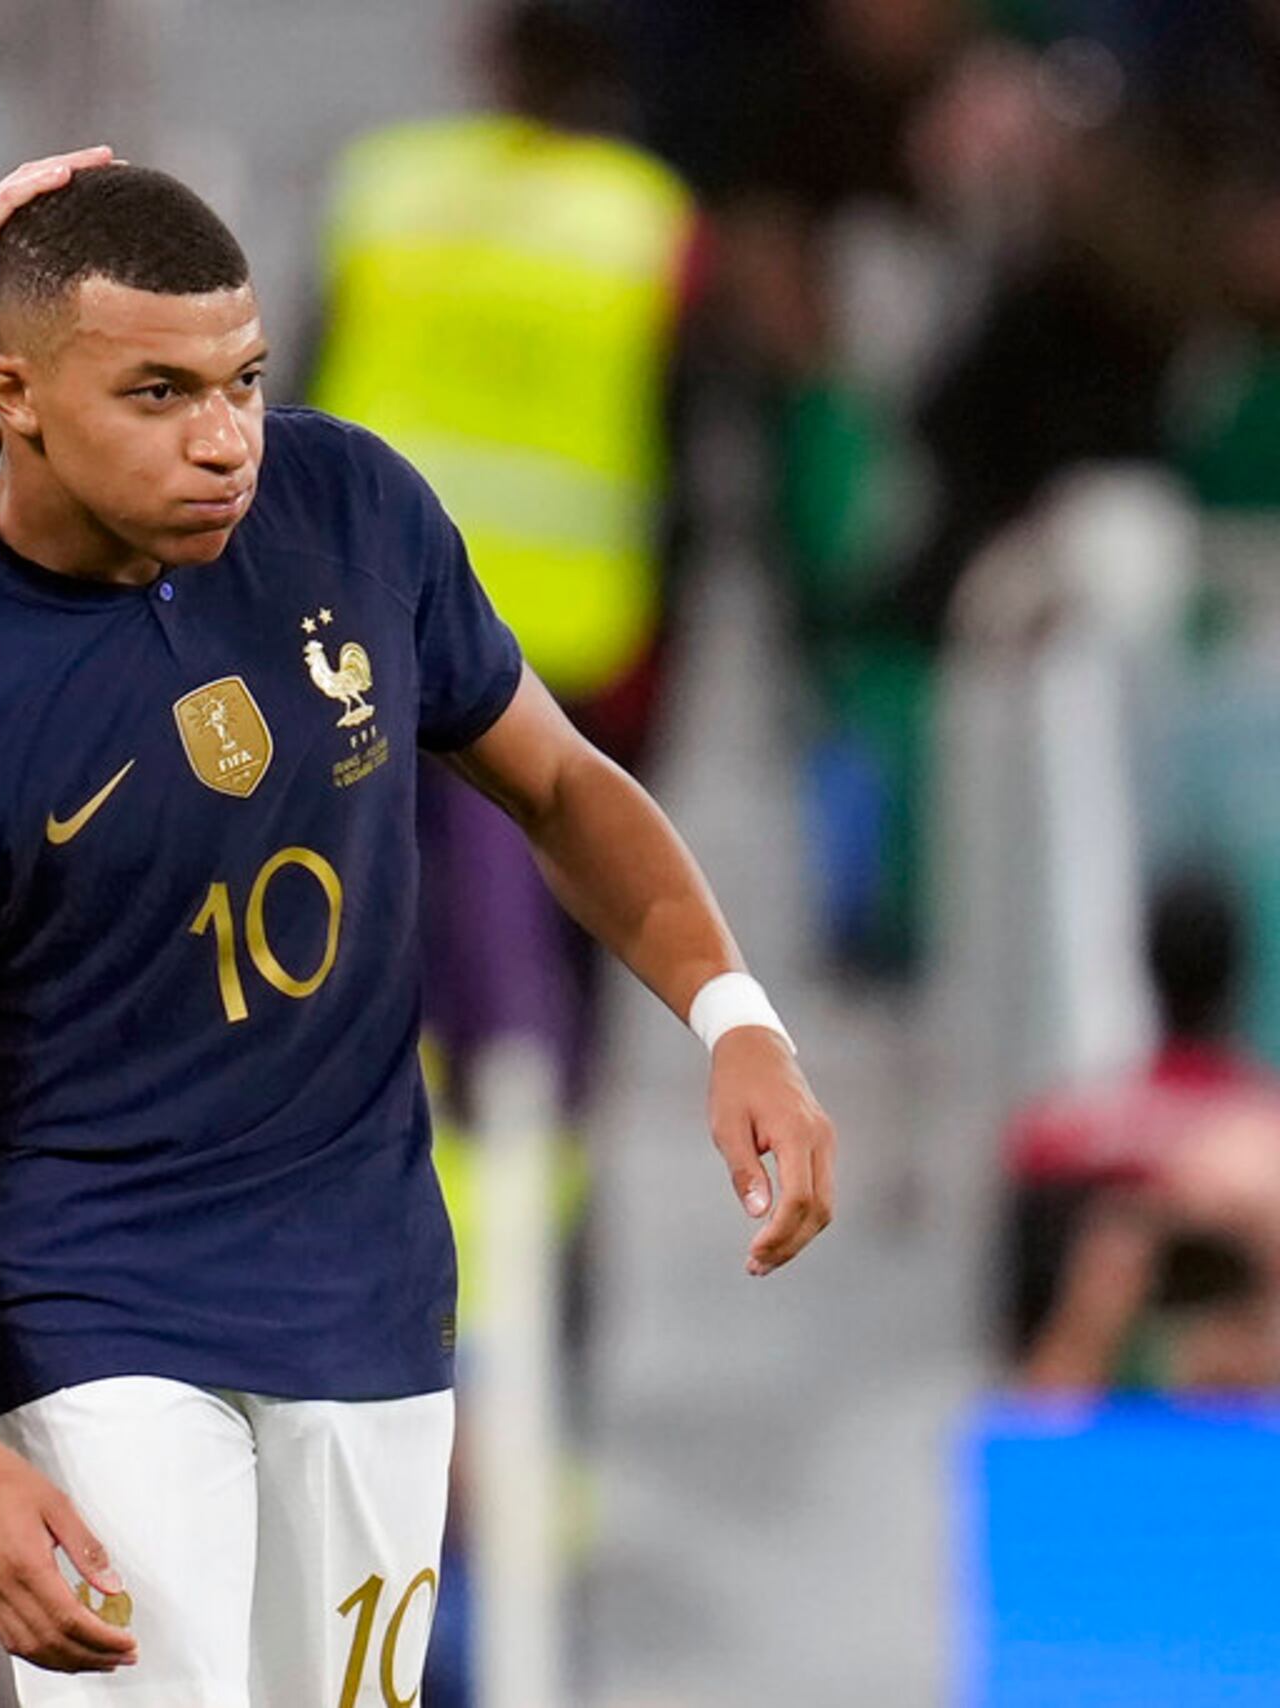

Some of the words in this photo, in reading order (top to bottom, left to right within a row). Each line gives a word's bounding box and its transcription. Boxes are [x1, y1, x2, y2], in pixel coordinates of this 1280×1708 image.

[219, 751, 252, 772] FIFA
[189, 847, 343, 1022] 10
[337, 1567, 437, 1708] 10
